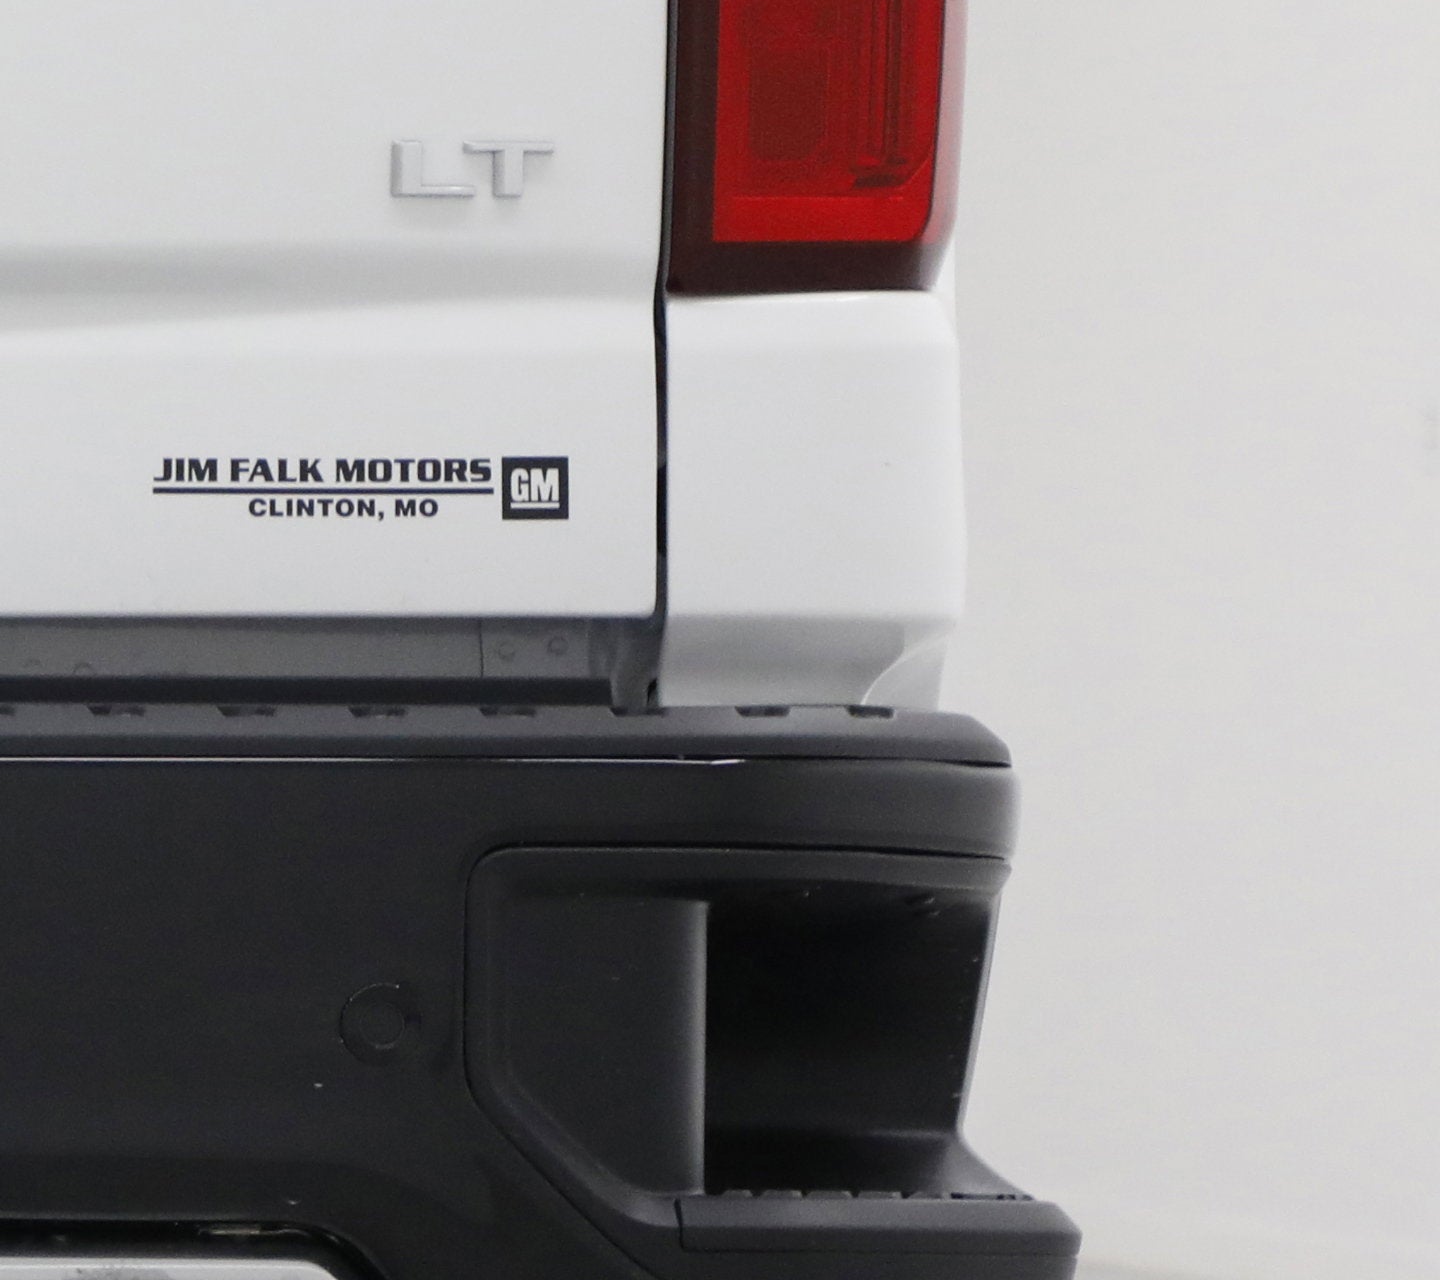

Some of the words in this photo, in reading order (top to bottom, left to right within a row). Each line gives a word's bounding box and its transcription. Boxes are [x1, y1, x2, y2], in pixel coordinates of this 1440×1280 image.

[389, 138, 556, 199] LT
[153, 457, 219, 484] JIM
[230, 457, 323, 484] FALK
[335, 457, 493, 484] MOTORS
[509, 467, 561, 504] GM
[247, 498, 386, 521] CLINTON,
[394, 498, 440, 518] MO
